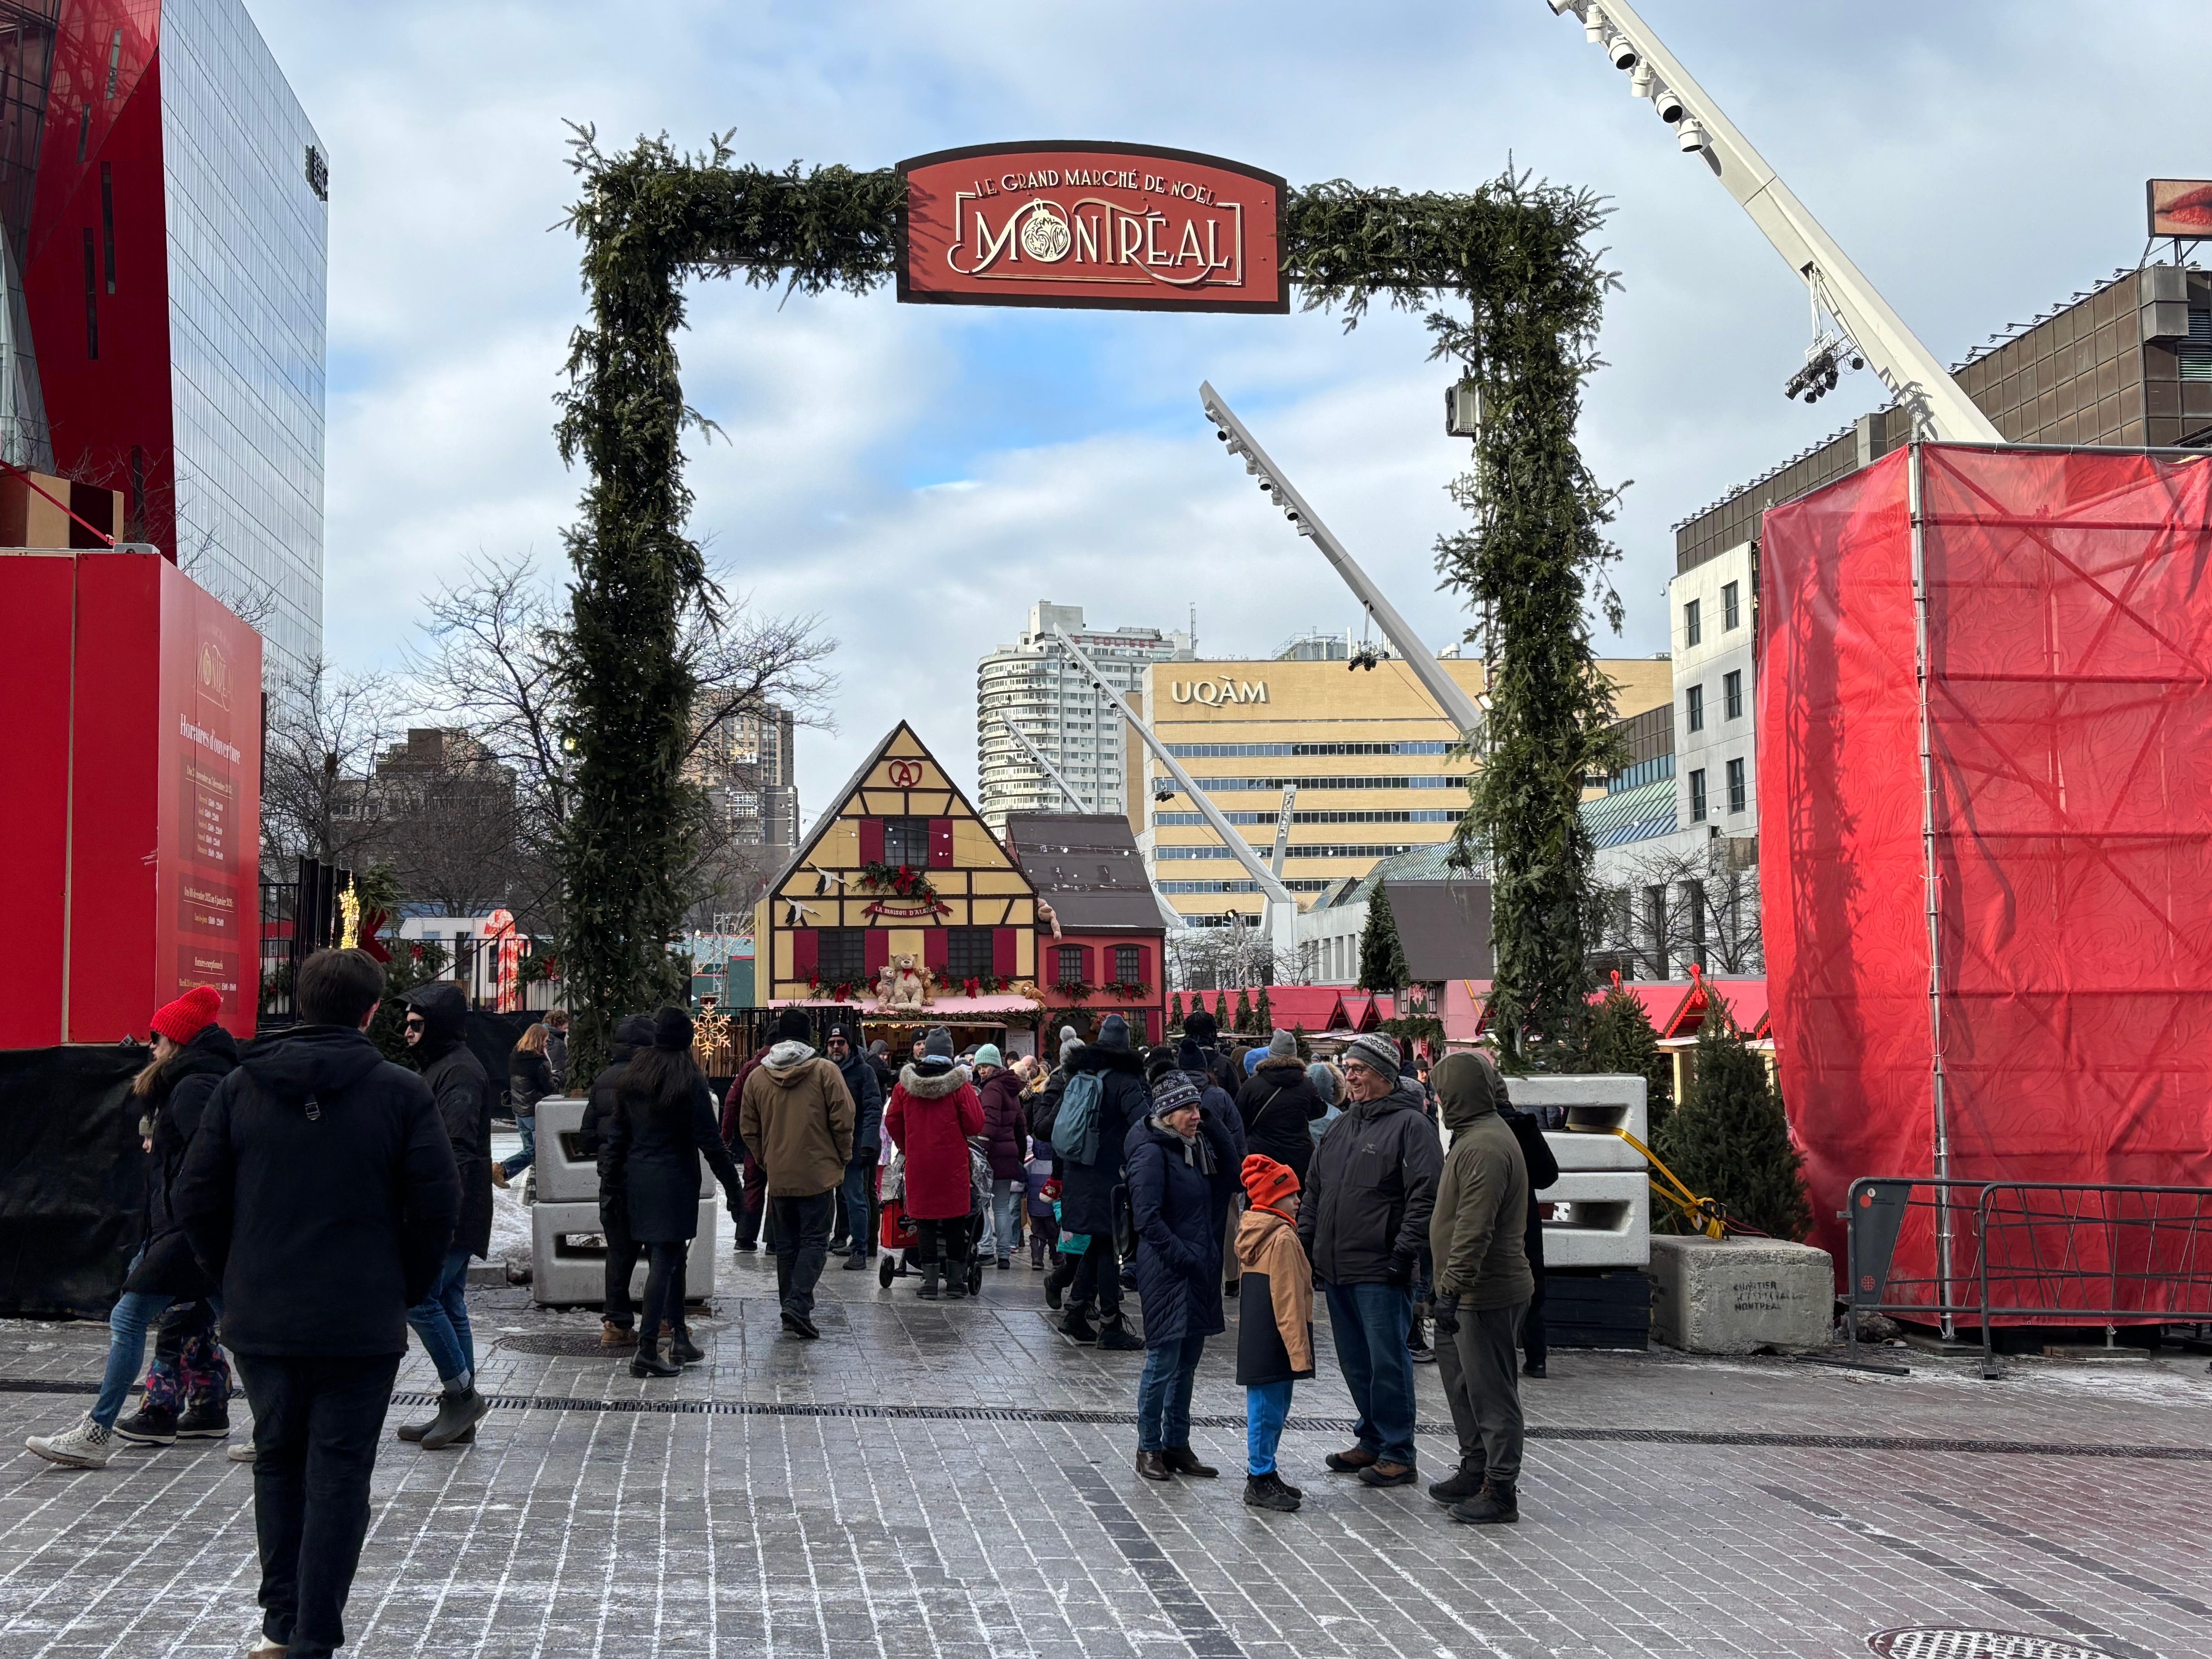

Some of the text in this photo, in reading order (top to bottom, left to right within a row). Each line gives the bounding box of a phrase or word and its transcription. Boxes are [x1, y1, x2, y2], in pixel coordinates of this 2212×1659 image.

[975, 178, 997, 197] LE
[1001, 170, 1059, 191] GRAND
[1065, 169, 1138, 189] MARCHÉ
[1144, 174, 1165, 193] DE
[948, 197, 1229, 285] MONTRÉAL
[1171, 675, 1266, 707] UQÀM
[180, 713, 241, 764] Horaires d'ouverture
